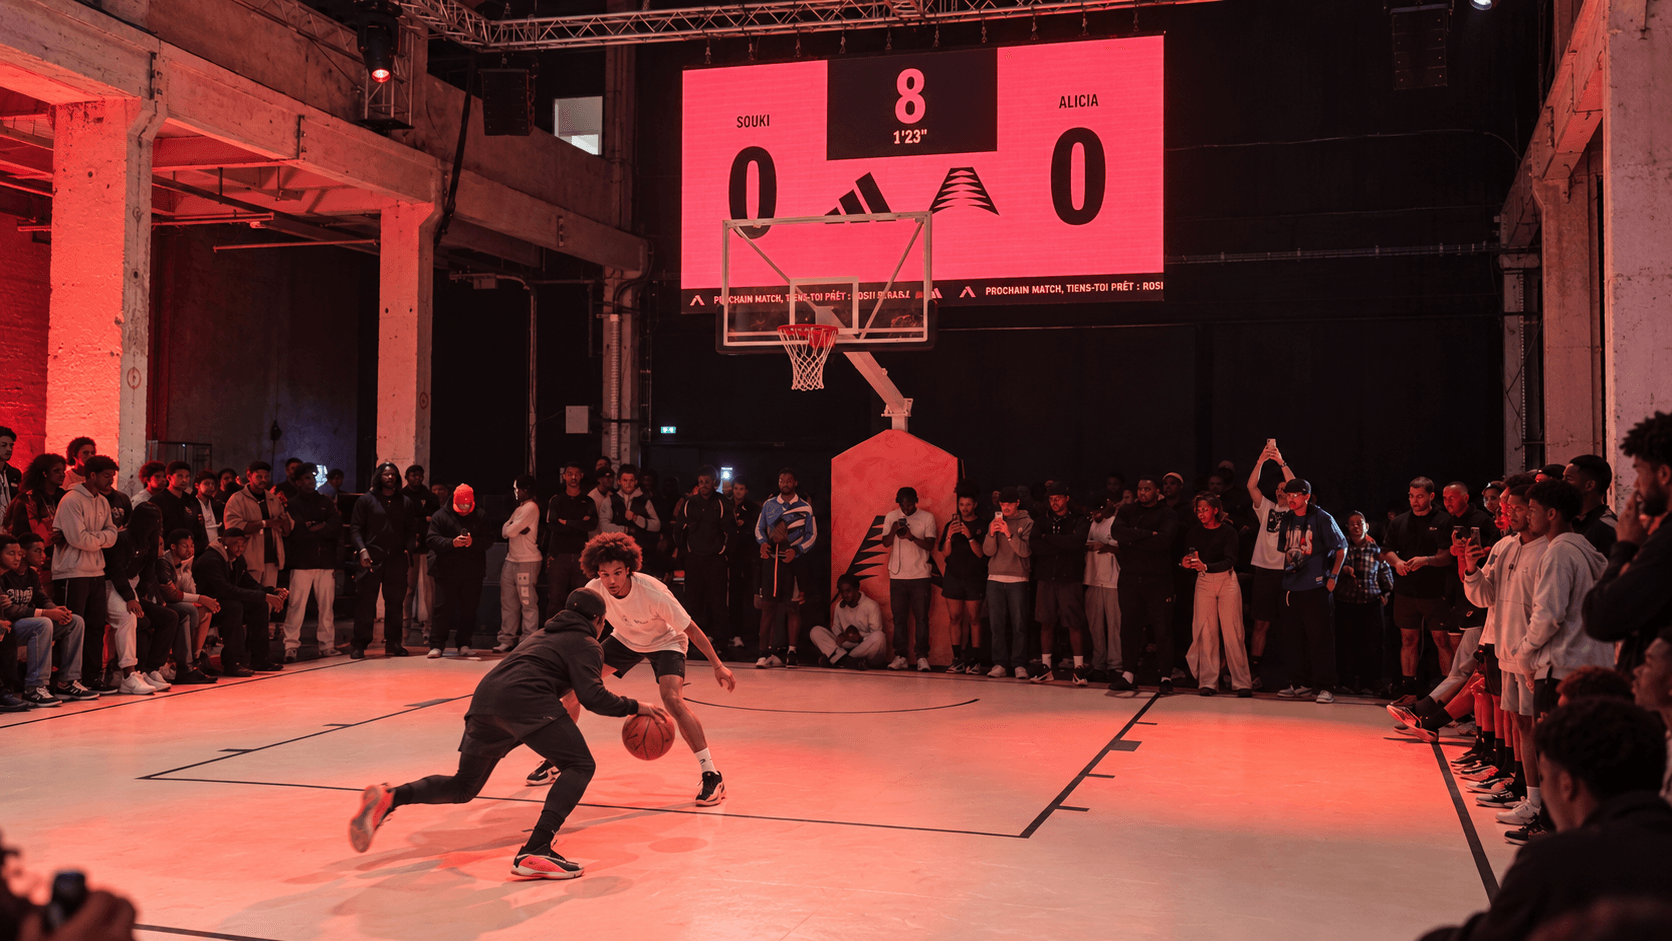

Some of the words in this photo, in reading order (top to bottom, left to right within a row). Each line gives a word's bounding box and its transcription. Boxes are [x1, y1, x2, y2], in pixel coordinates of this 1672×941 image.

[895, 68, 926, 124] 8
[1058, 93, 1099, 109] ALICIA
[736, 114, 770, 128] SOUKI
[1050, 127, 1106, 225] 0
[729, 146, 777, 239] 0
[985, 286, 1030, 296] PROCHAIN
[1032, 284, 1064, 294] MATCH,
[1066, 282, 1108, 293] TIENS-TOI
[1111, 280, 1134, 291] PRÊT
[713, 294, 753, 304] PCHAIN
[785, 292, 823, 302] TENS-TOI
